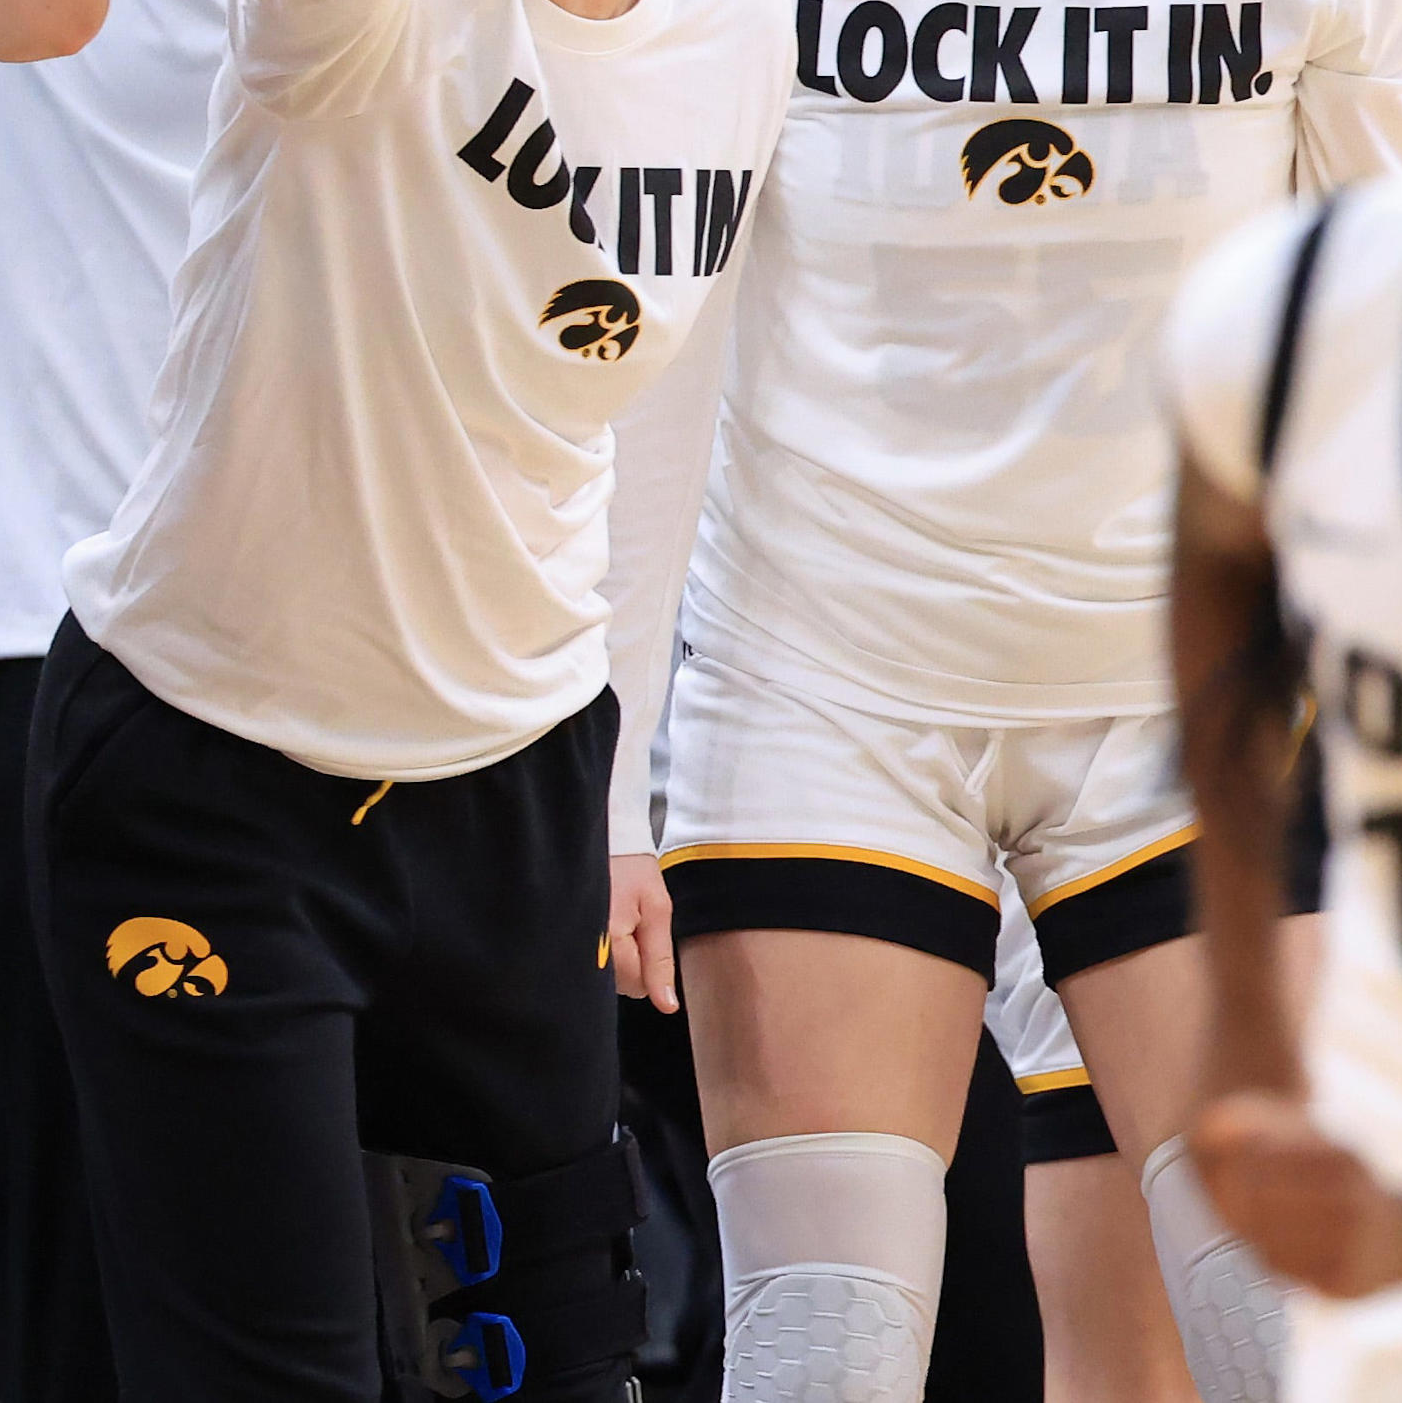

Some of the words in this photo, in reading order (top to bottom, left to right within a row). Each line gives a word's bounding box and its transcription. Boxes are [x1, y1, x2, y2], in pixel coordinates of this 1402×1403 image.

[1061, 5, 1149, 105] IT
[1167, 2, 1273, 105] IN.
[617, 167, 683, 276] IT
